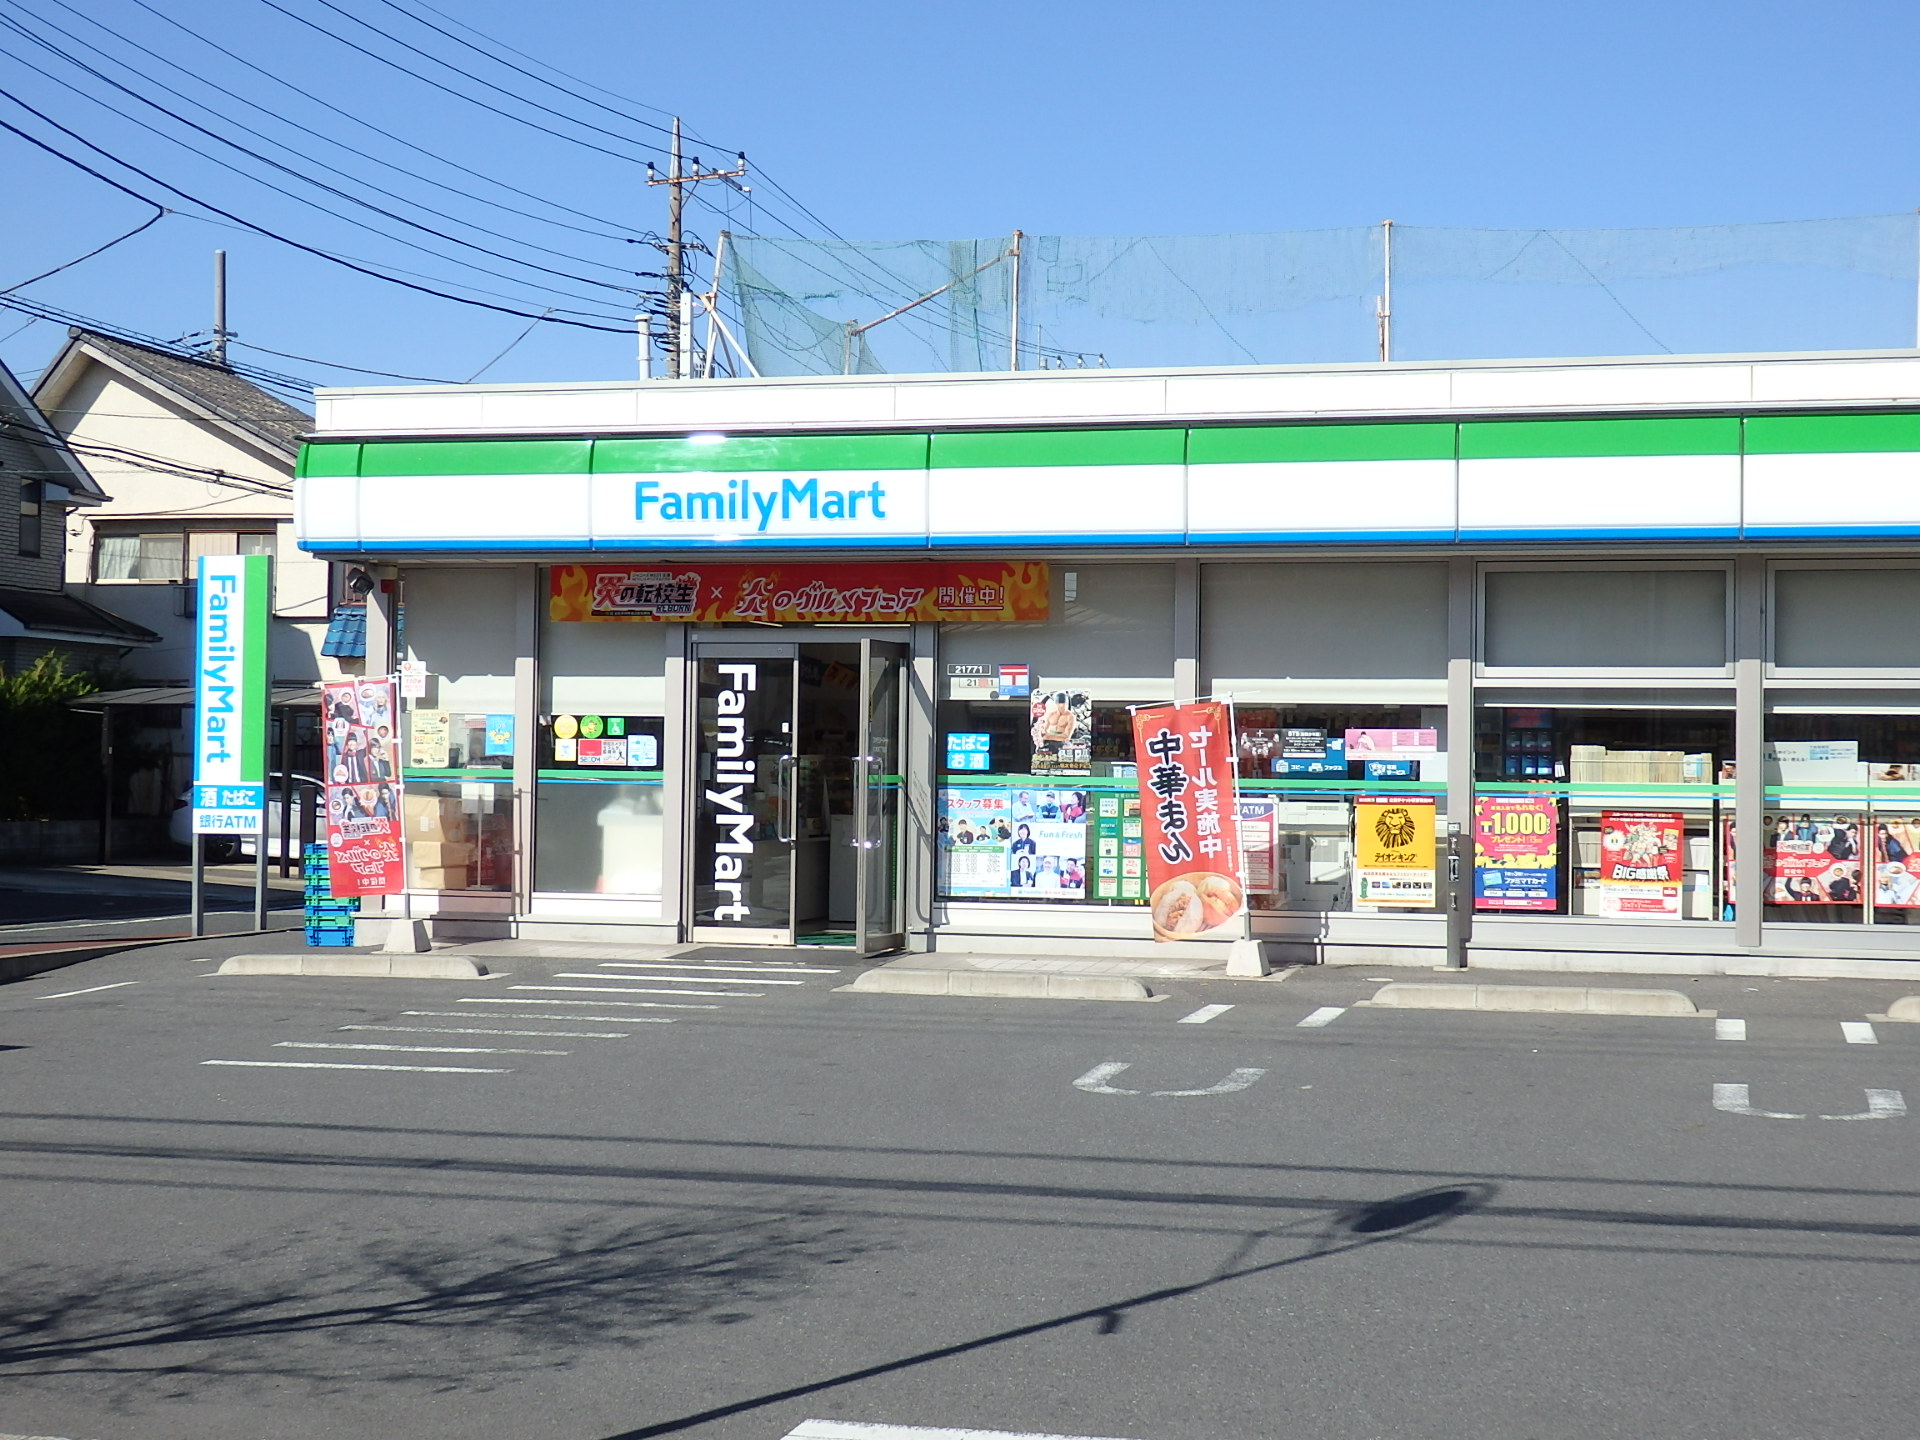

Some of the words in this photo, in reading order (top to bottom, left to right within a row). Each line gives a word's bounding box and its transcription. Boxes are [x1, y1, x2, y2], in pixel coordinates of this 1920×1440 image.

[634, 477, 886, 532] FamilyMart
[594, 575, 697, 608] 炎の転校生
[734, 577, 925, 615] 炎のグルメフェア
[938, 585, 1005, 605] 開催中!
[656, 605, 692, 613] REBORN
[202, 574, 236, 764] FamilyMart
[955, 665, 983, 674] 21771
[966, 678, 994, 687] 211
[947, 734, 990, 751] たばこ
[951, 753, 985, 768] お酒
[199, 787, 218, 808] 酒
[221, 788, 256, 806] たばこ
[705, 663, 757, 922] FamilyMart
[946, 798, 1004, 810] スタッフ募集
[199, 814, 257, 829] 銀行ATM
[1491, 811, 1548, 835] 1,000
[1038, 830, 1054, 838] Fun
[1061, 830, 1083, 839] Fresh
